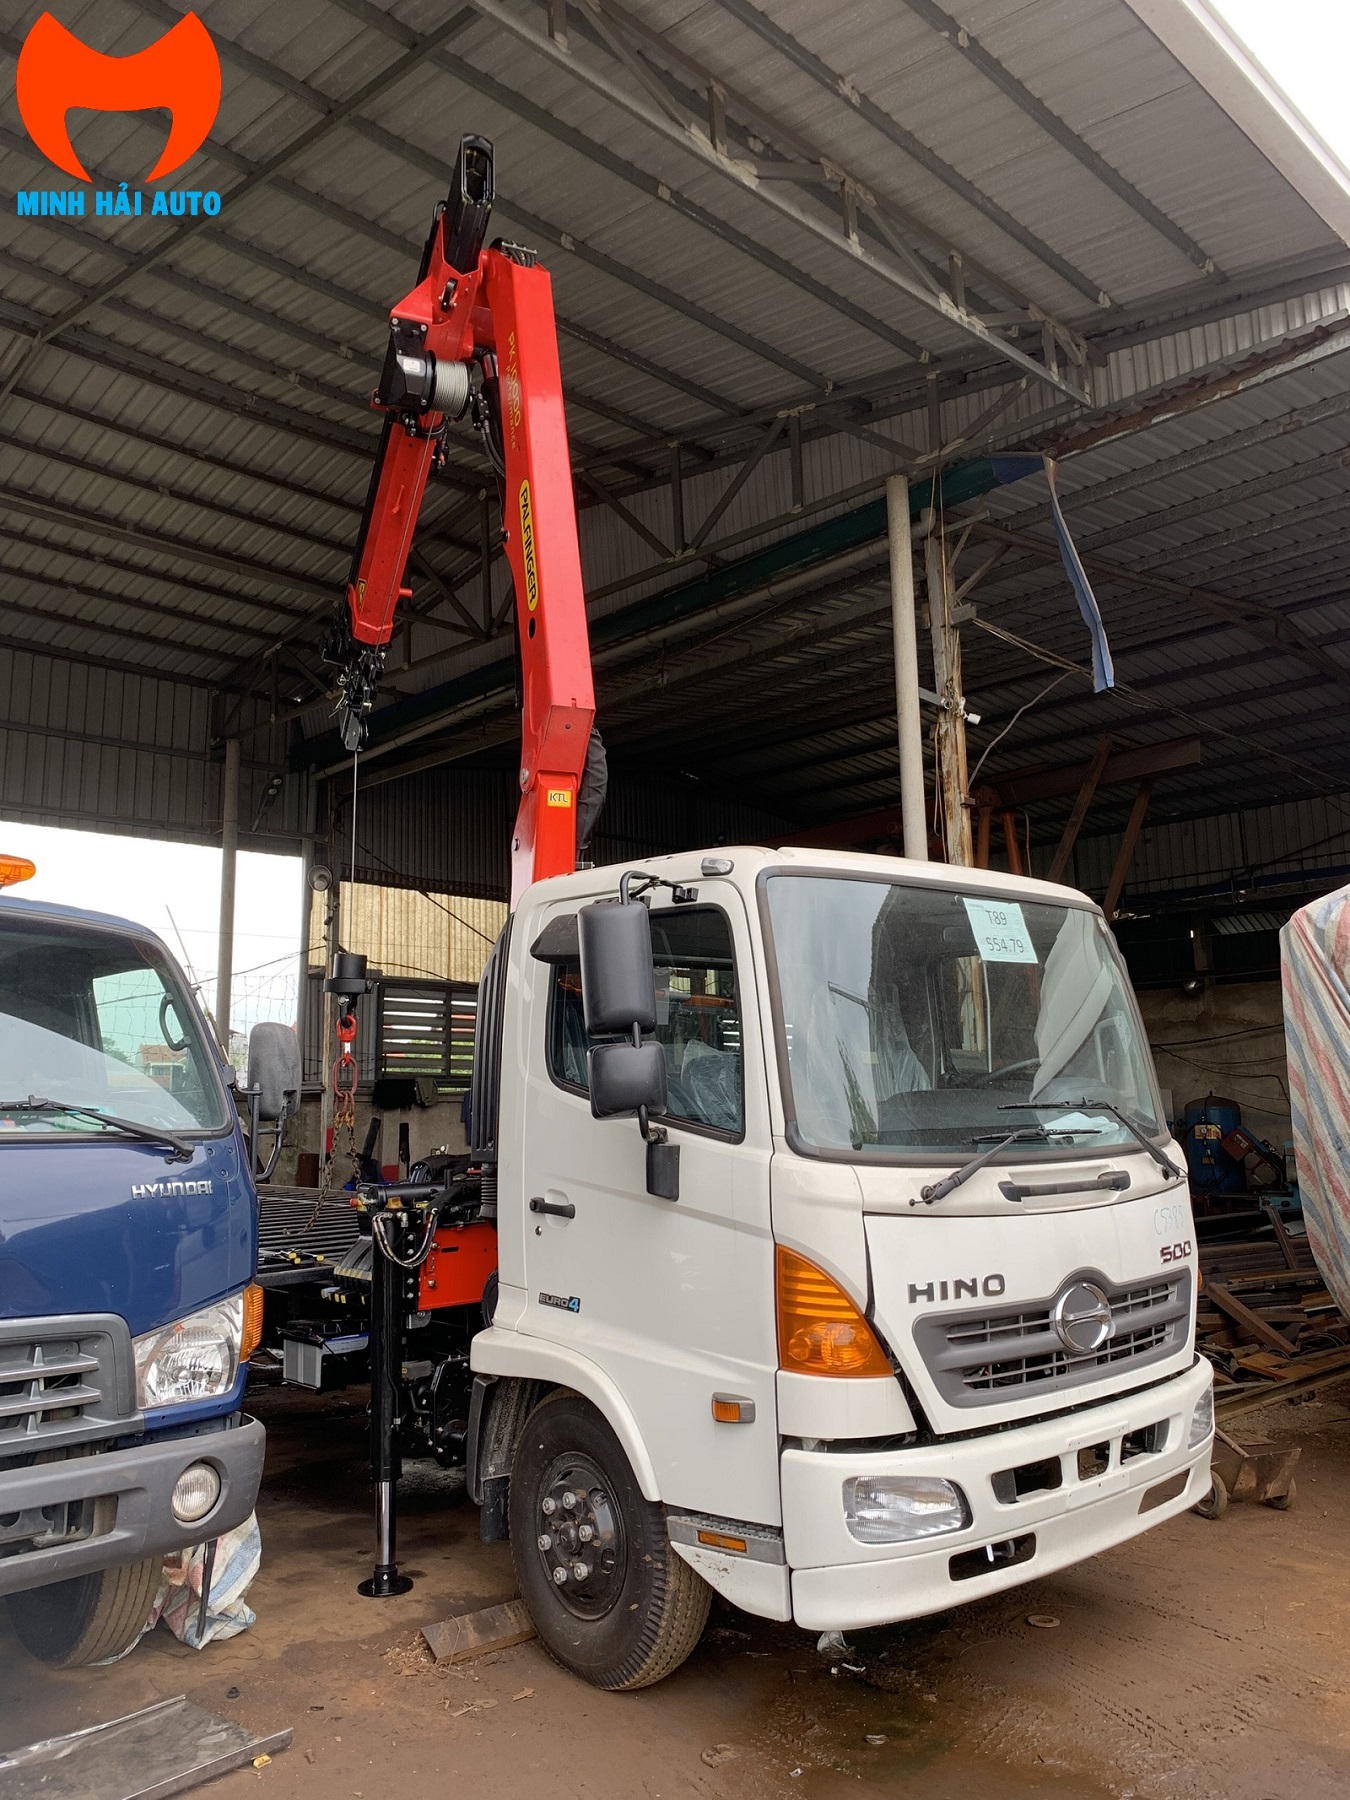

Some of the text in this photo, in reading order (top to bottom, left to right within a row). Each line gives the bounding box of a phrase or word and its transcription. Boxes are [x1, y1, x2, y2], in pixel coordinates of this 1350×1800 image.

[507, 332, 521, 427] PK 10000
[506, 364, 516, 449] Performance
[520, 486, 537, 605] PALFINGER
[985, 910, 1008, 926] T89
[985, 937, 1025, 953] 554.79
[131, 1180, 213, 1200] HYUNDAI
[1160, 1240, 1192, 1264] 500
[907, 1273, 1006, 1304] HINO
